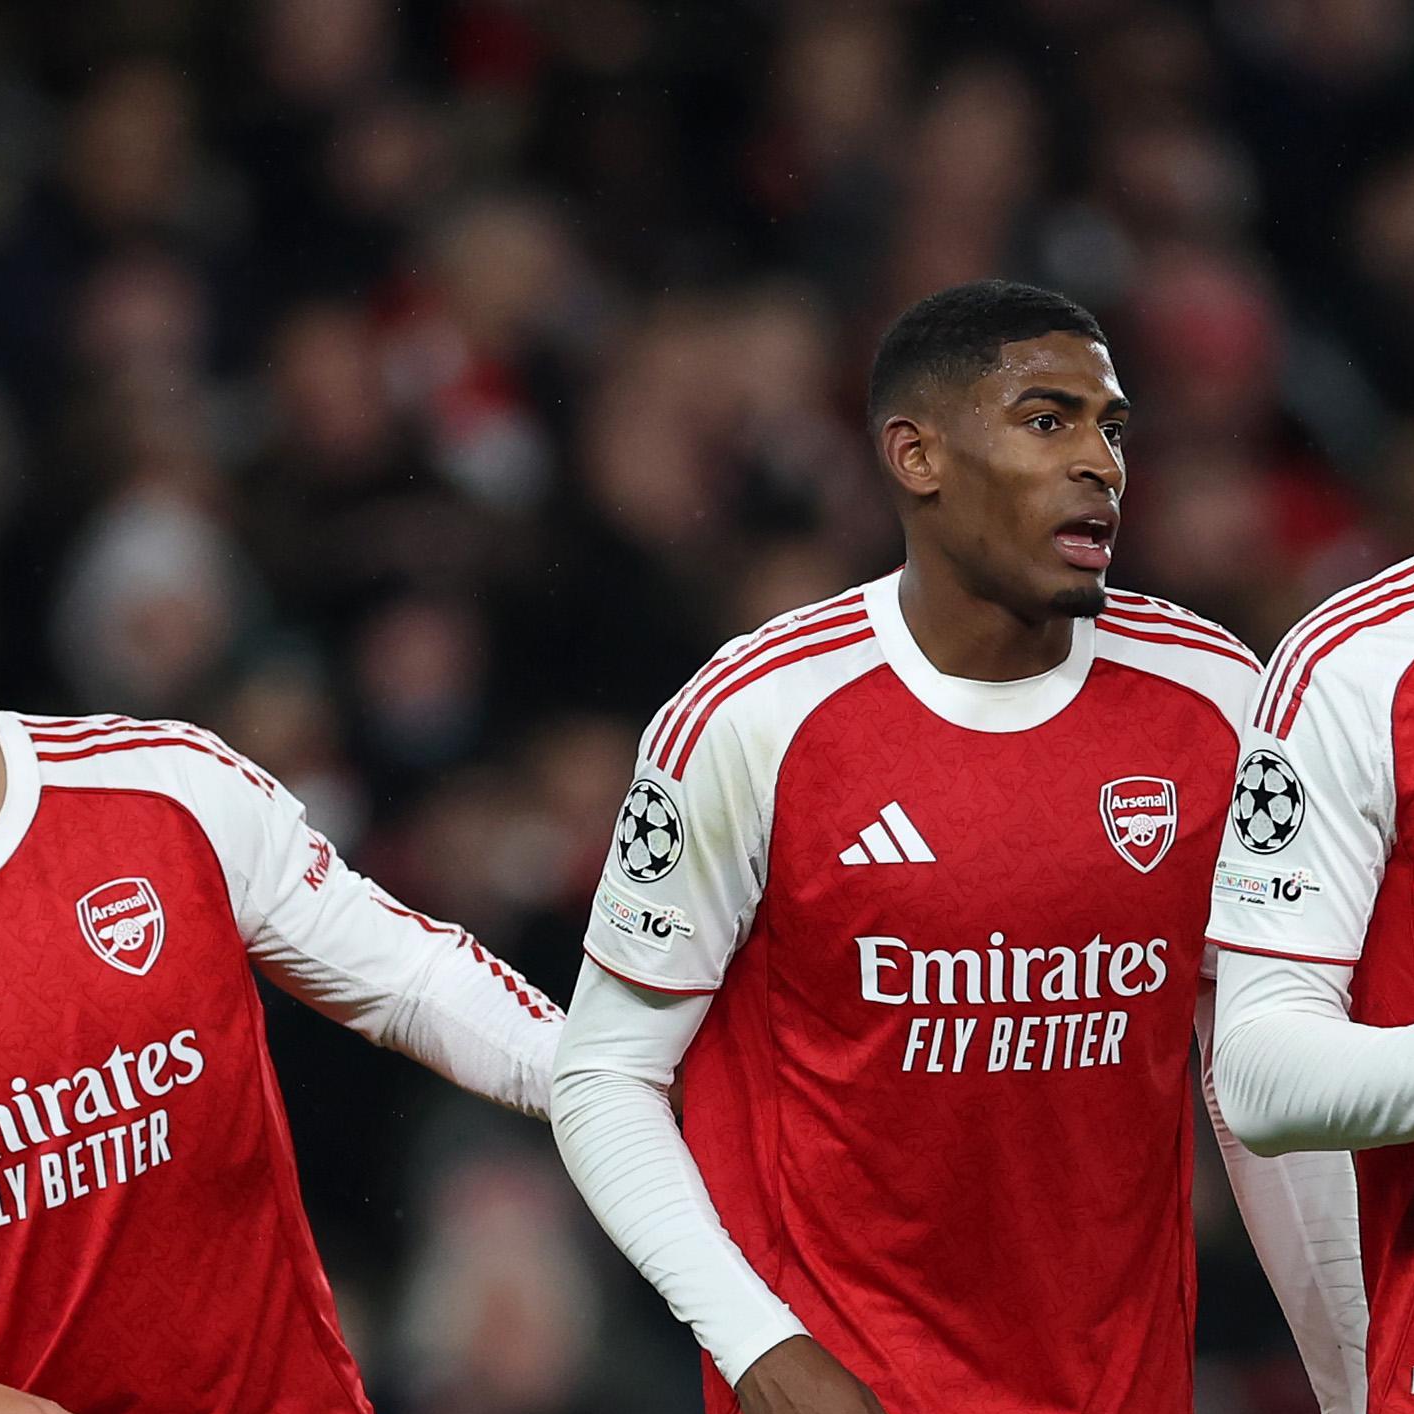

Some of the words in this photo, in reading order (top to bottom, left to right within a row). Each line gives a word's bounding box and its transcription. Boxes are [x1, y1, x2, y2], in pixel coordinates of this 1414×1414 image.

[1111, 791, 1166, 809] Arsenal
[91, 891, 147, 923] Arsenal
[854, 931, 1168, 1005] Emirates
[902, 1018, 977, 1073] FLY
[987, 1011, 1128, 1073] BETTER
[40, 1108, 172, 1210] BETTER
